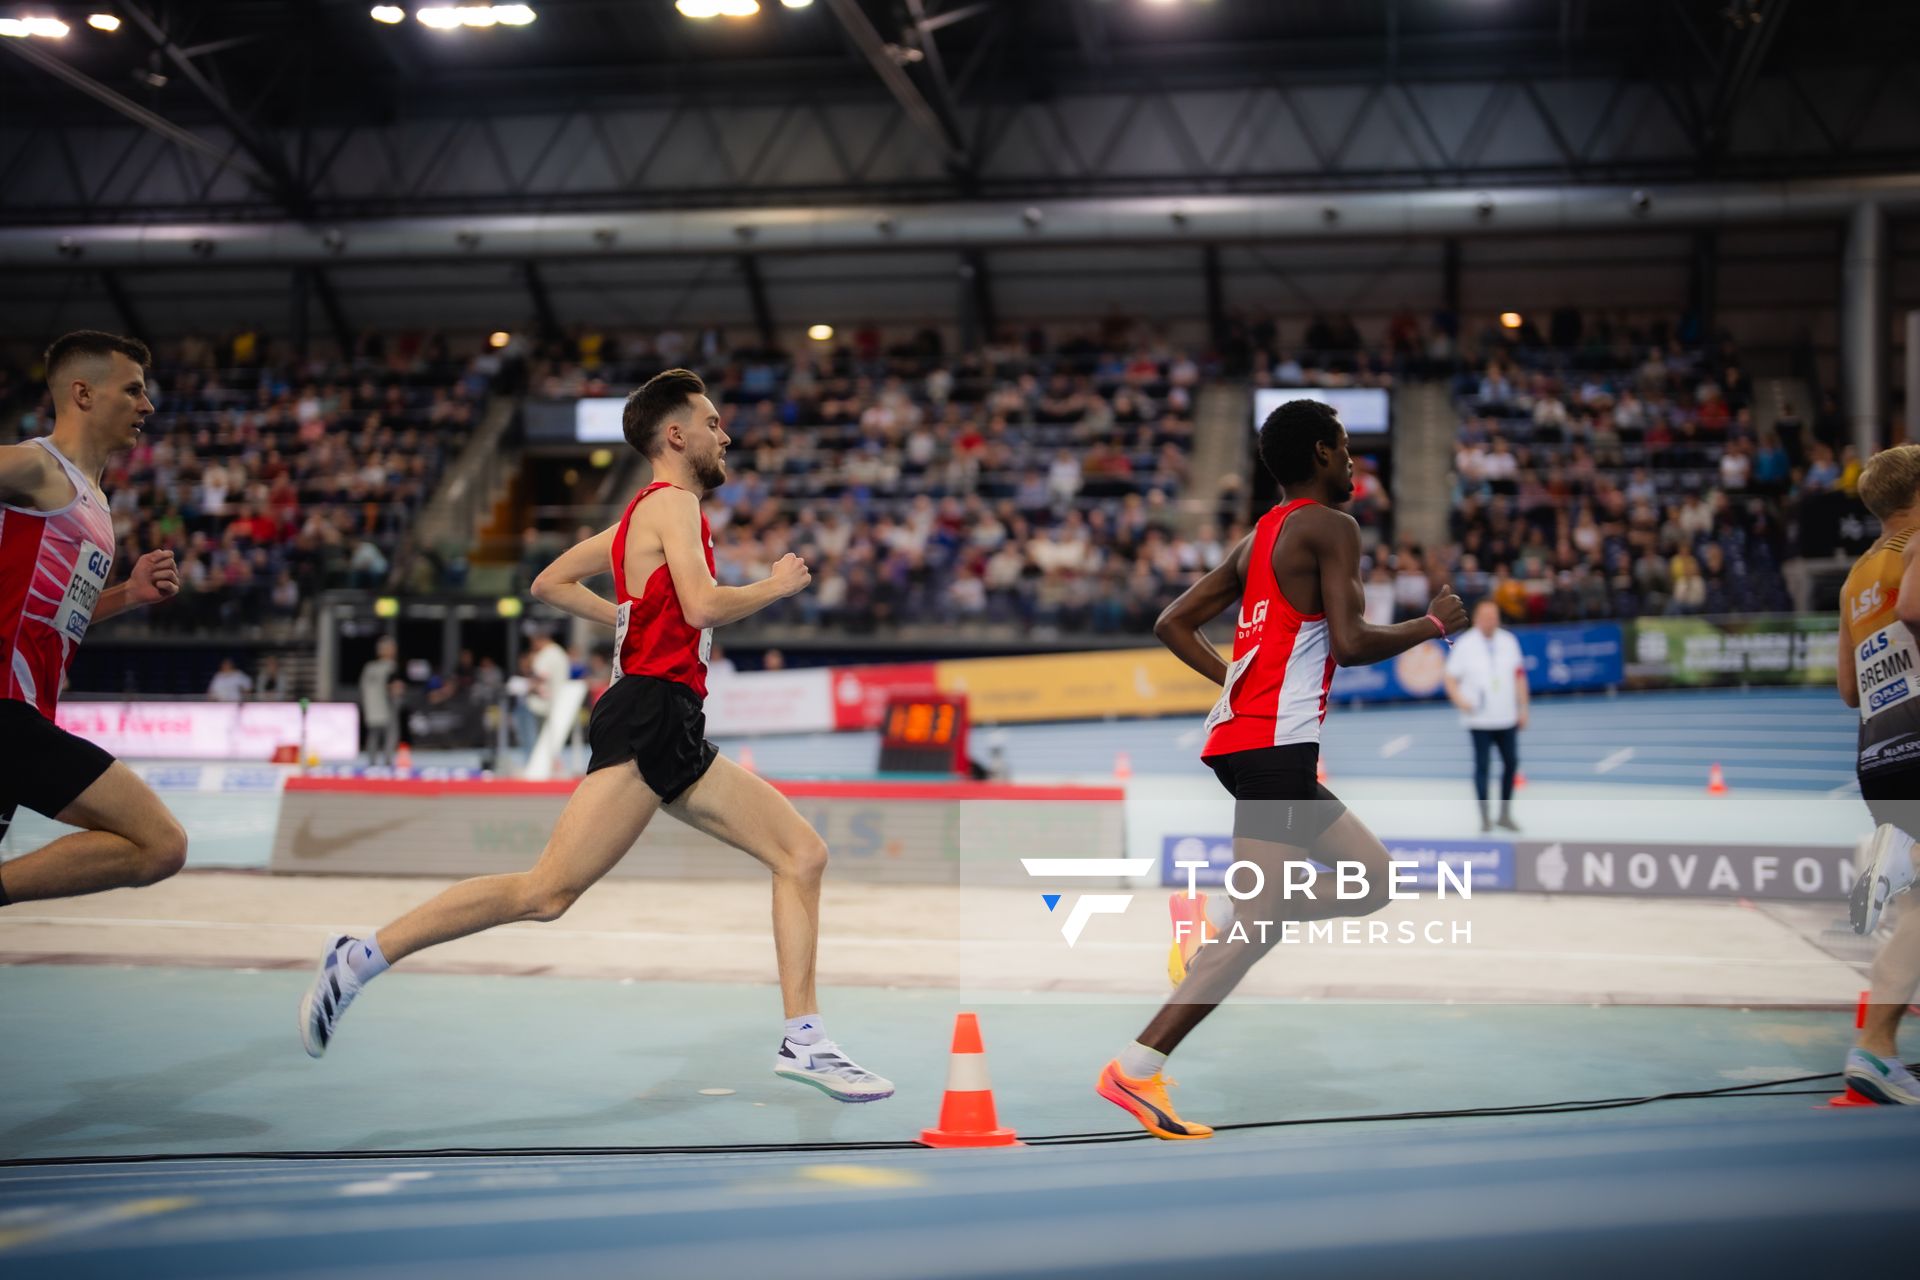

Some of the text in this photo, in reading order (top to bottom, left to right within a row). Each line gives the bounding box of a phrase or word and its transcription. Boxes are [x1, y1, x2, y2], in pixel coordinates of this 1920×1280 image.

[88, 551, 110, 579] GLS
[1851, 581, 1882, 620] LSC
[1861, 649, 1913, 693] BREMM
